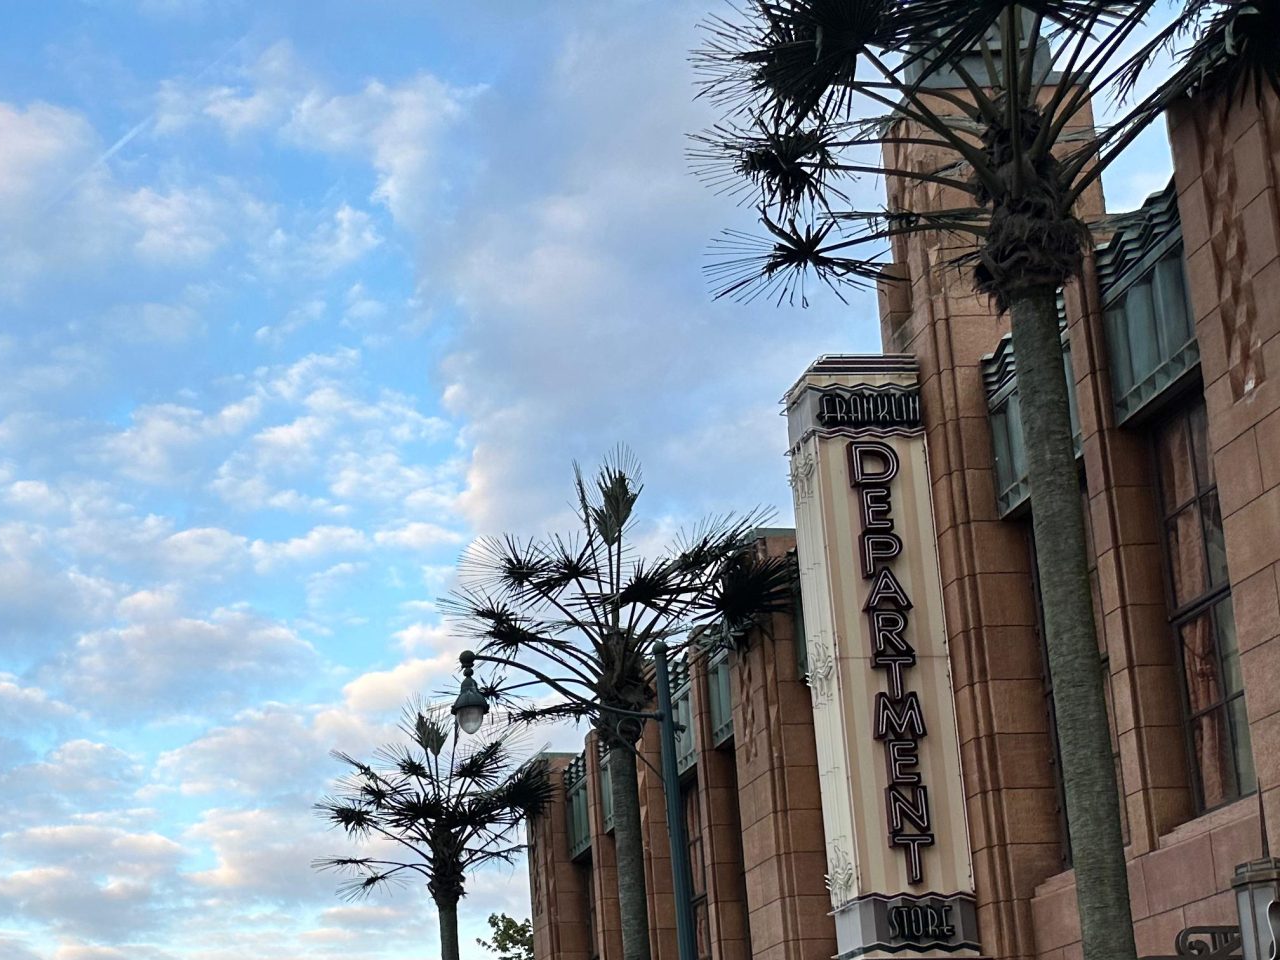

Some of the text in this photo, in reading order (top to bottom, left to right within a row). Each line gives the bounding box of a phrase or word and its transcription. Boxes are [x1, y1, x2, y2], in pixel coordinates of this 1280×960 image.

[817, 392, 920, 427] FRANKLIN
[846, 440, 935, 886] DEPARTMENT
[888, 904, 956, 939] STORE
